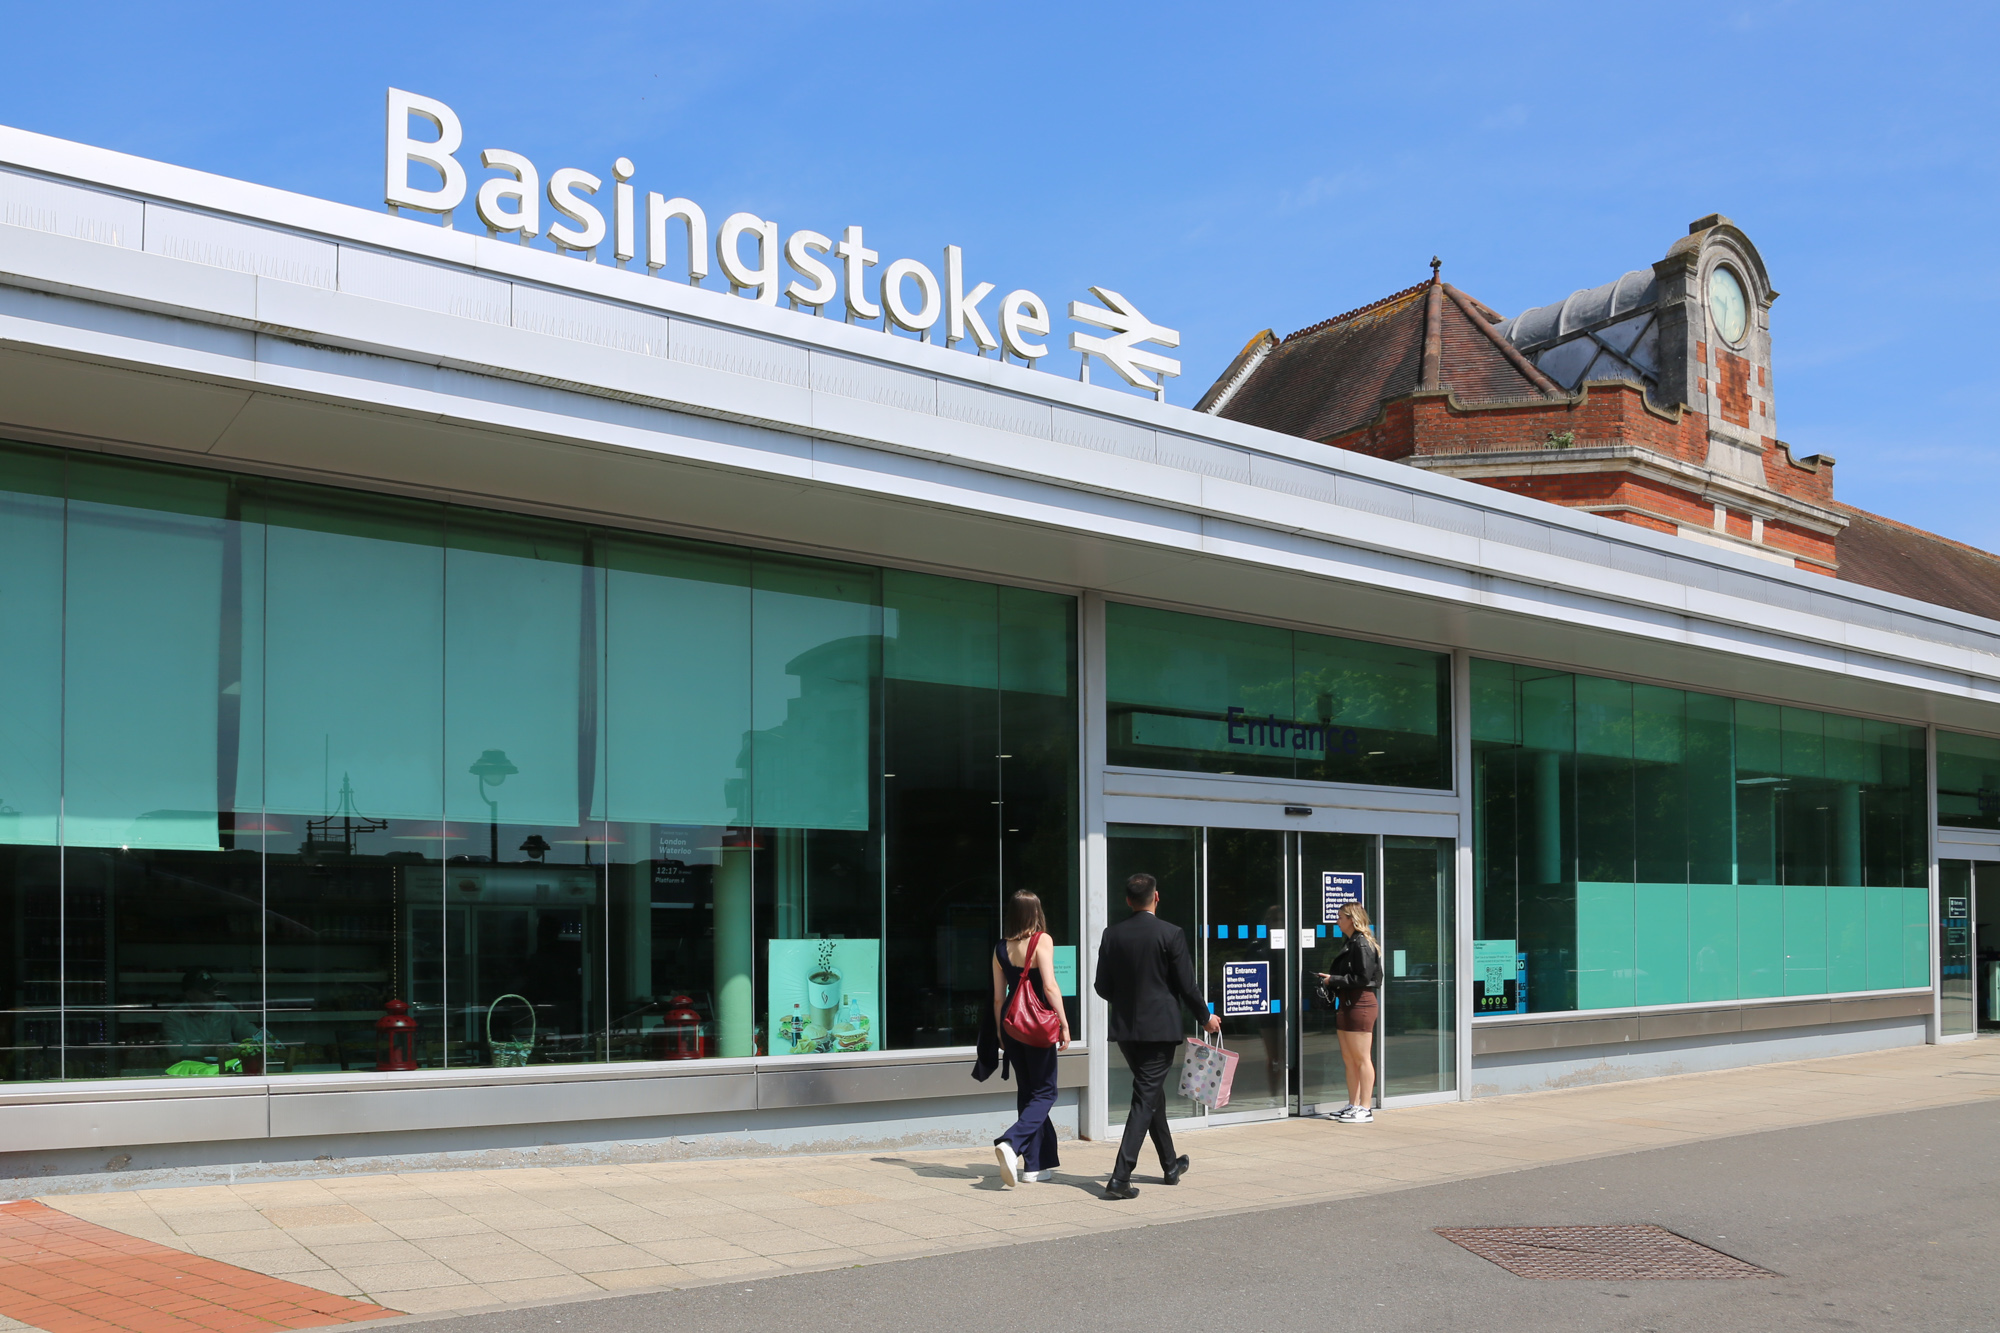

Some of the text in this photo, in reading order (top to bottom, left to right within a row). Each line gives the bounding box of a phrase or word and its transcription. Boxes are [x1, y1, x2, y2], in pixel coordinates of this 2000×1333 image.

[386, 87, 1050, 359] Basingstoke
[1227, 706, 1358, 754] Entrance
[659, 846, 692, 854] Waterloo
